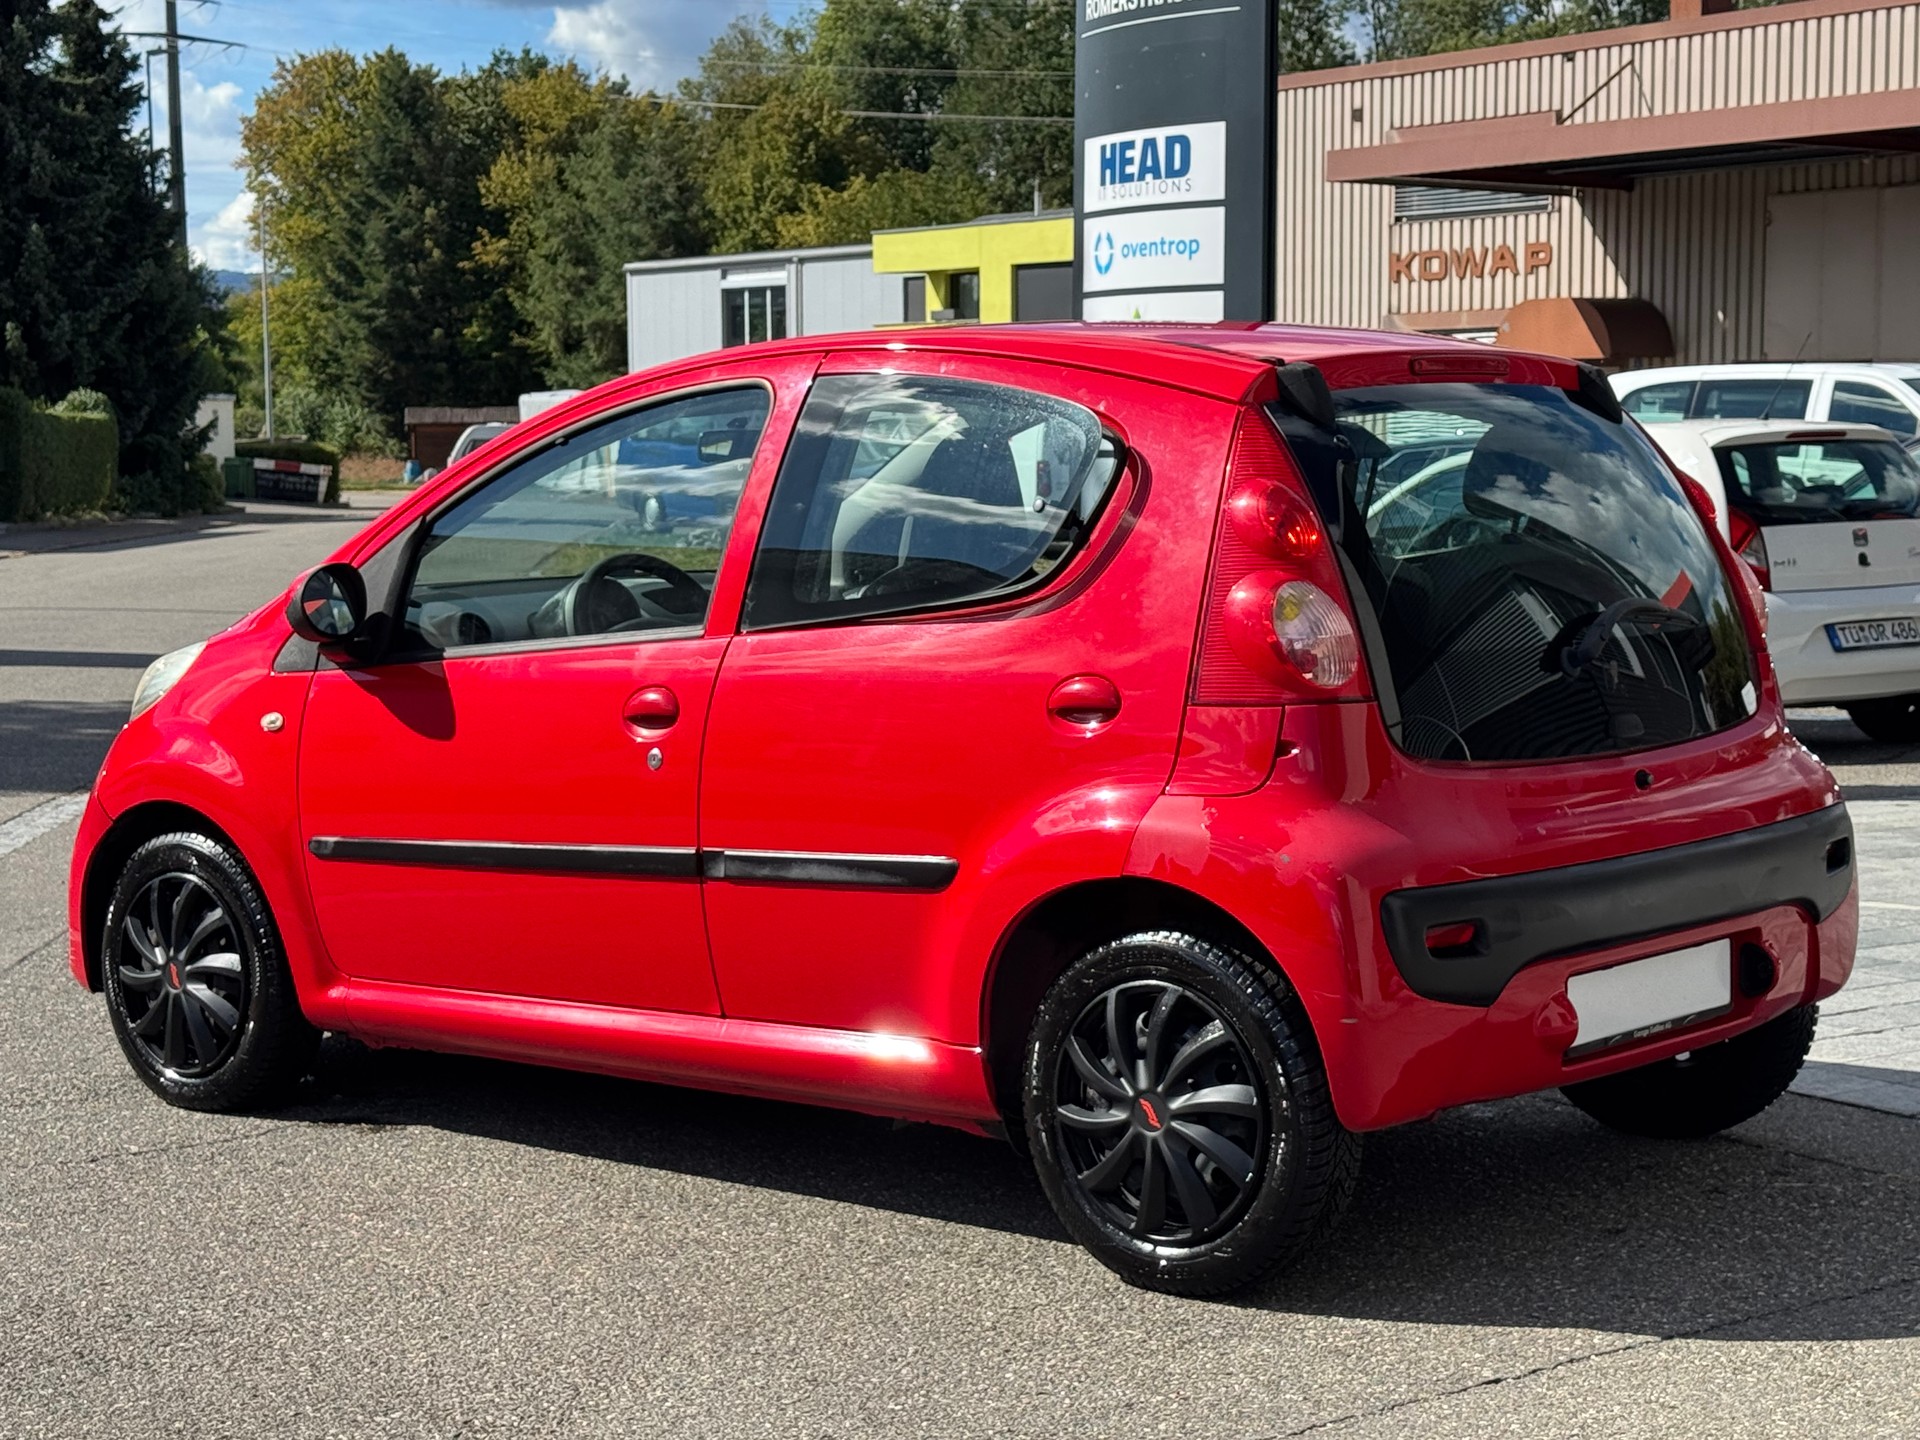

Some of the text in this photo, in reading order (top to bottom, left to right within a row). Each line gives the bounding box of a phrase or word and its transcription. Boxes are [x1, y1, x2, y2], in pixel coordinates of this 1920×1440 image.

[1100, 134, 1191, 186] HEAD
[1111, 178, 1192, 199] SOLUTIONS
[1121, 236, 1200, 260] oventrop
[1389, 242, 1552, 283] KOWAP
[1891, 621, 1918, 640] 486
